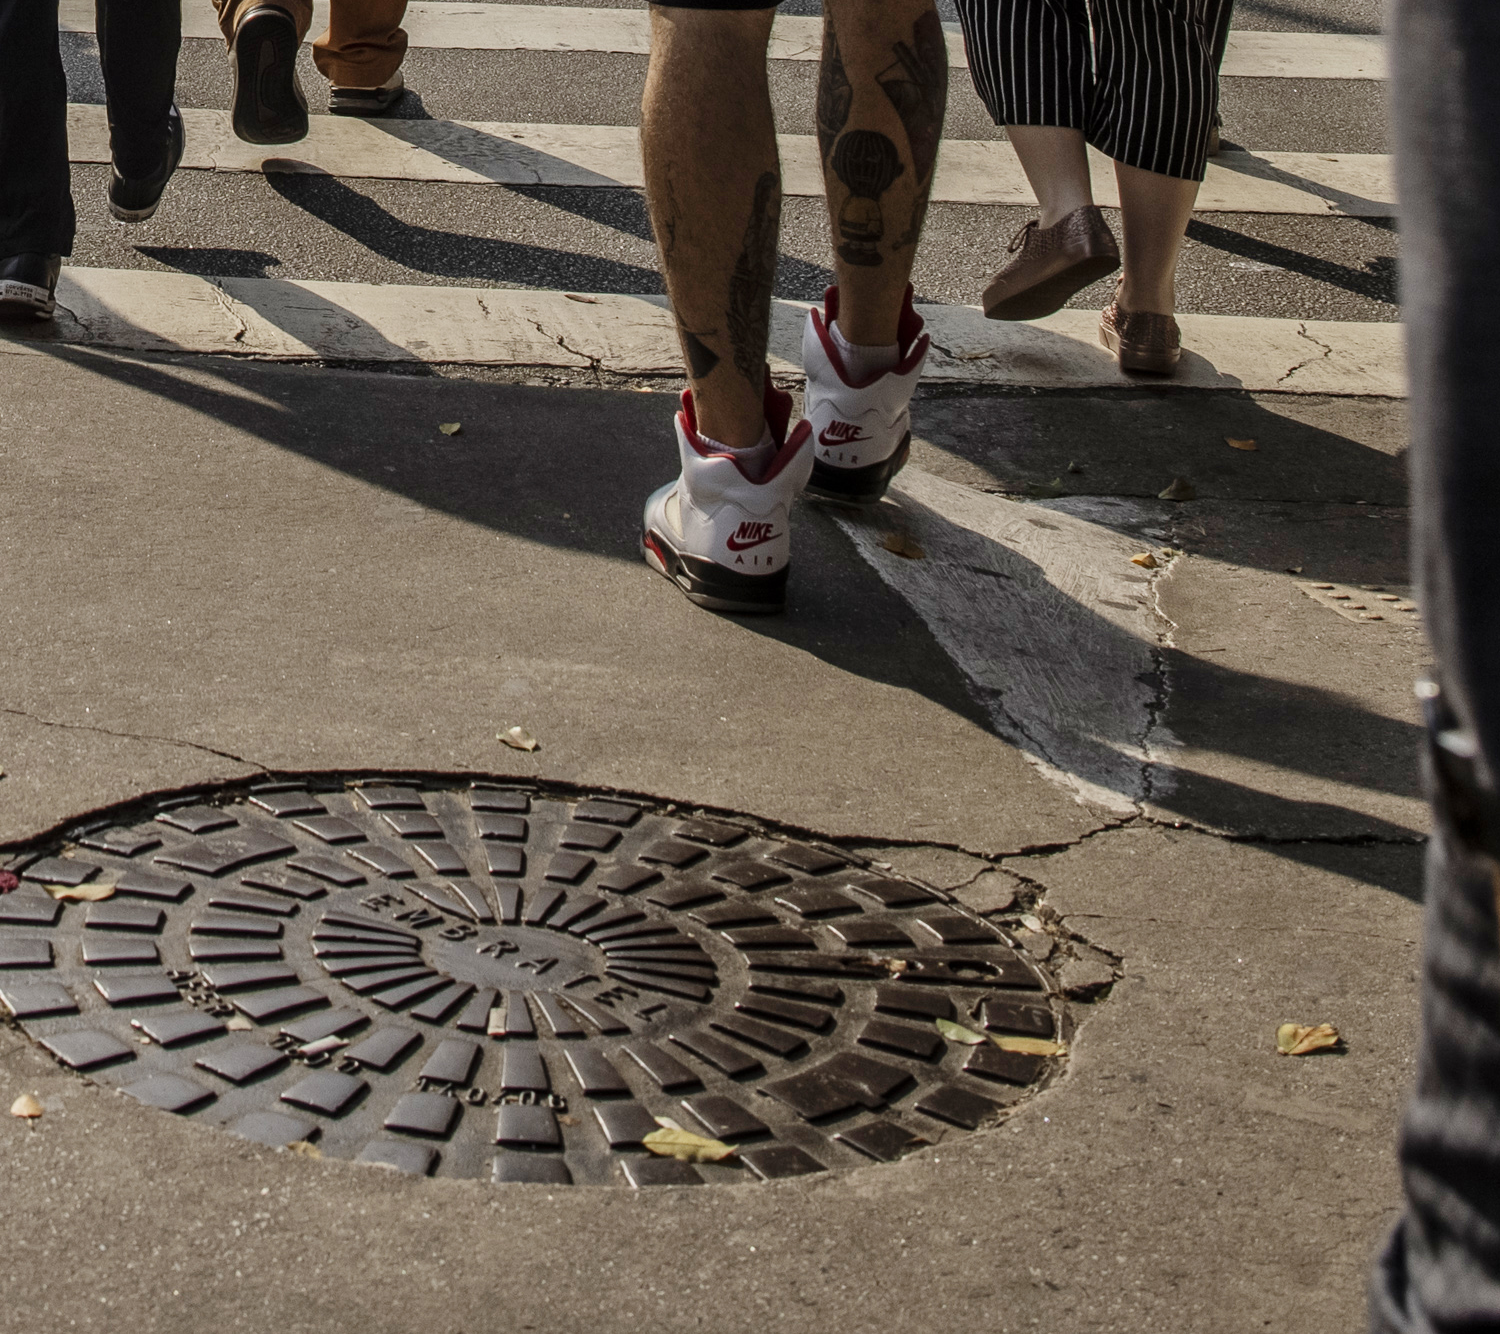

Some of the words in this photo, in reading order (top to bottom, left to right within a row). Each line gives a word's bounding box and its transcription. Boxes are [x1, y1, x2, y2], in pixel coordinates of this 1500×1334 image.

[826, 420, 863, 438] NIKE
[822, 449, 859, 464] AIR
[736, 521, 774, 539] NIKE
[735, 554, 773, 566] AIR
[358, 893, 669, 1023] EMBRATEL
